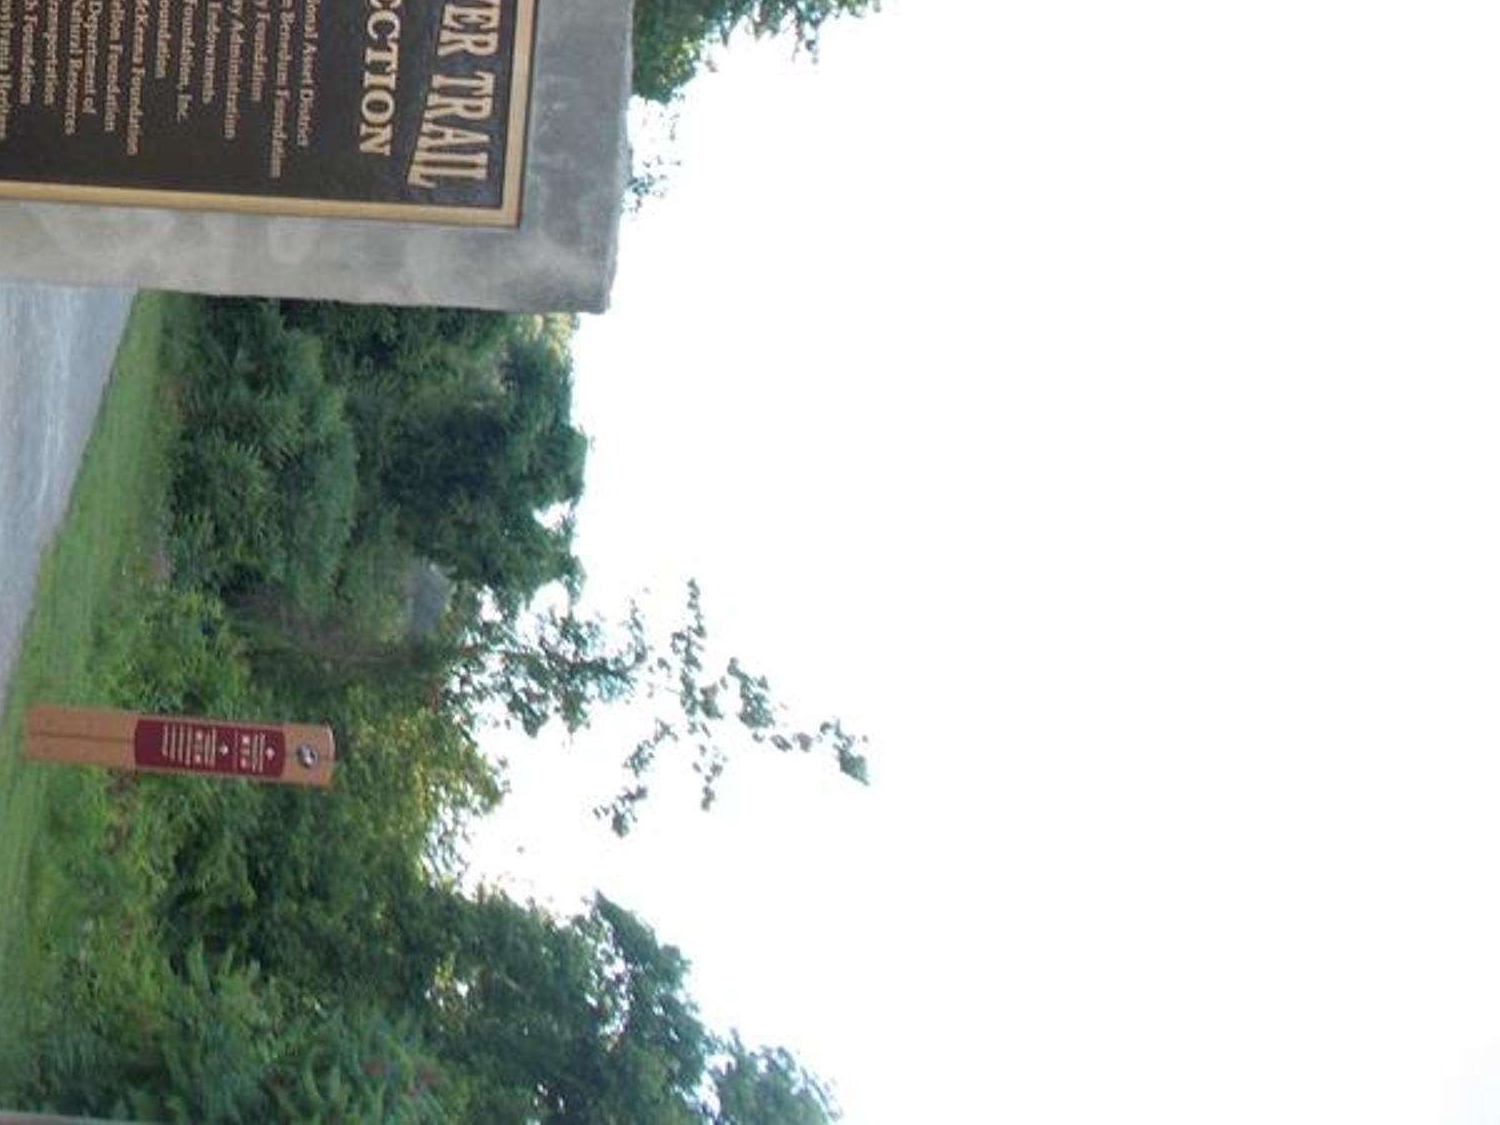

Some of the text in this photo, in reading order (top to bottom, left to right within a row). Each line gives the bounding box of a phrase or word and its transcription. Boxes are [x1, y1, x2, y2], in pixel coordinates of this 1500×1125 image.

[20, 14, 38, 105] Foundation
[83, 0, 102, 94] Department
[104, 45, 123, 132] Foundation
[202, 2, 221, 104] Endowments
[224, 19, 245, 139] Administration
[251, 11, 270, 101] Foundation
[301, 42, 317, 85] Asset
[65, 58, 83, 135] Resources
[82, 97, 97, 115] of
[127, 67, 145, 155] Foundation
[270, 89, 290, 178] Foundation
[297, 89, 314, 147] District
[408, 71, 496, 188] TRAIL
